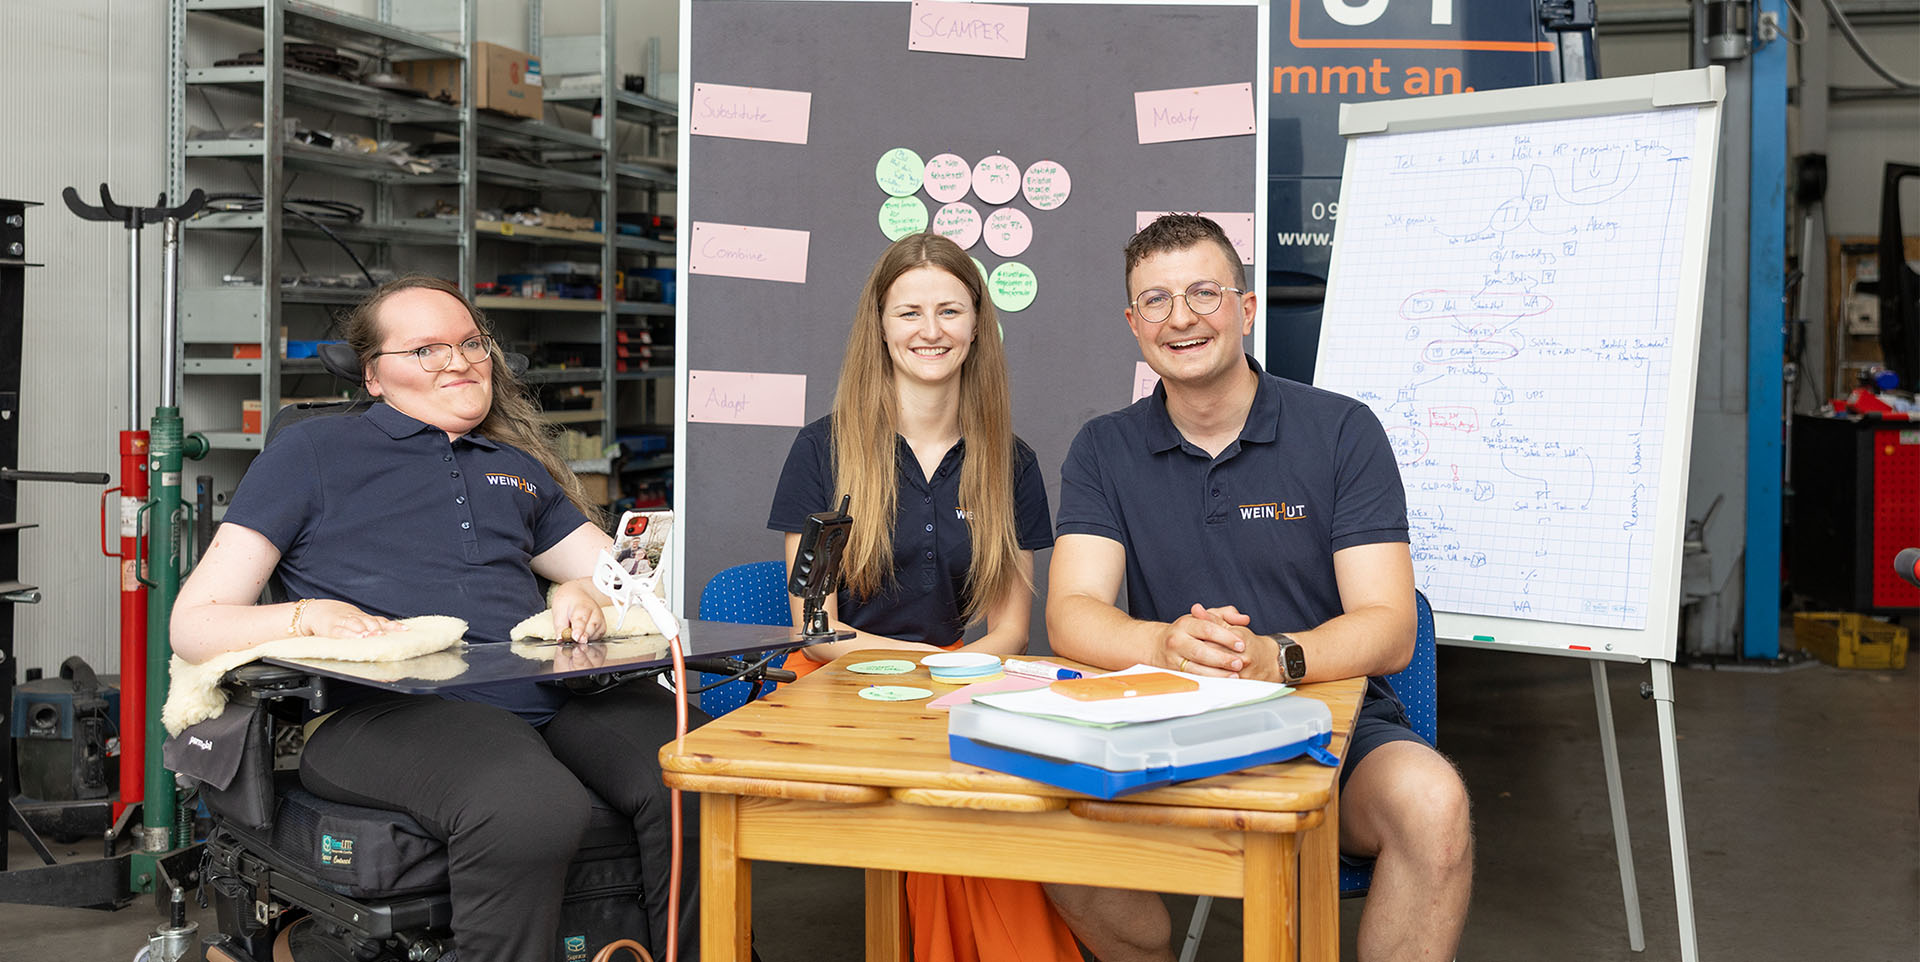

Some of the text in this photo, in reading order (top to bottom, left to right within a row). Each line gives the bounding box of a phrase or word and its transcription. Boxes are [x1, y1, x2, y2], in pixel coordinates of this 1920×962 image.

[915, 12, 1009, 43] SCAMPER
[1403, 66, 1476, 95] an.
[700, 96, 773, 123] Substitute
[1152, 107, 1199, 132] Modify
[702, 236, 768, 262] Combine
[1277, 231, 1334, 247] www.
[704, 386, 751, 419] Adapt
[486, 474, 538, 498] WEINHUT
[1239, 502, 1306, 520] WEINHUT
[1513, 600, 1532, 613] WA
